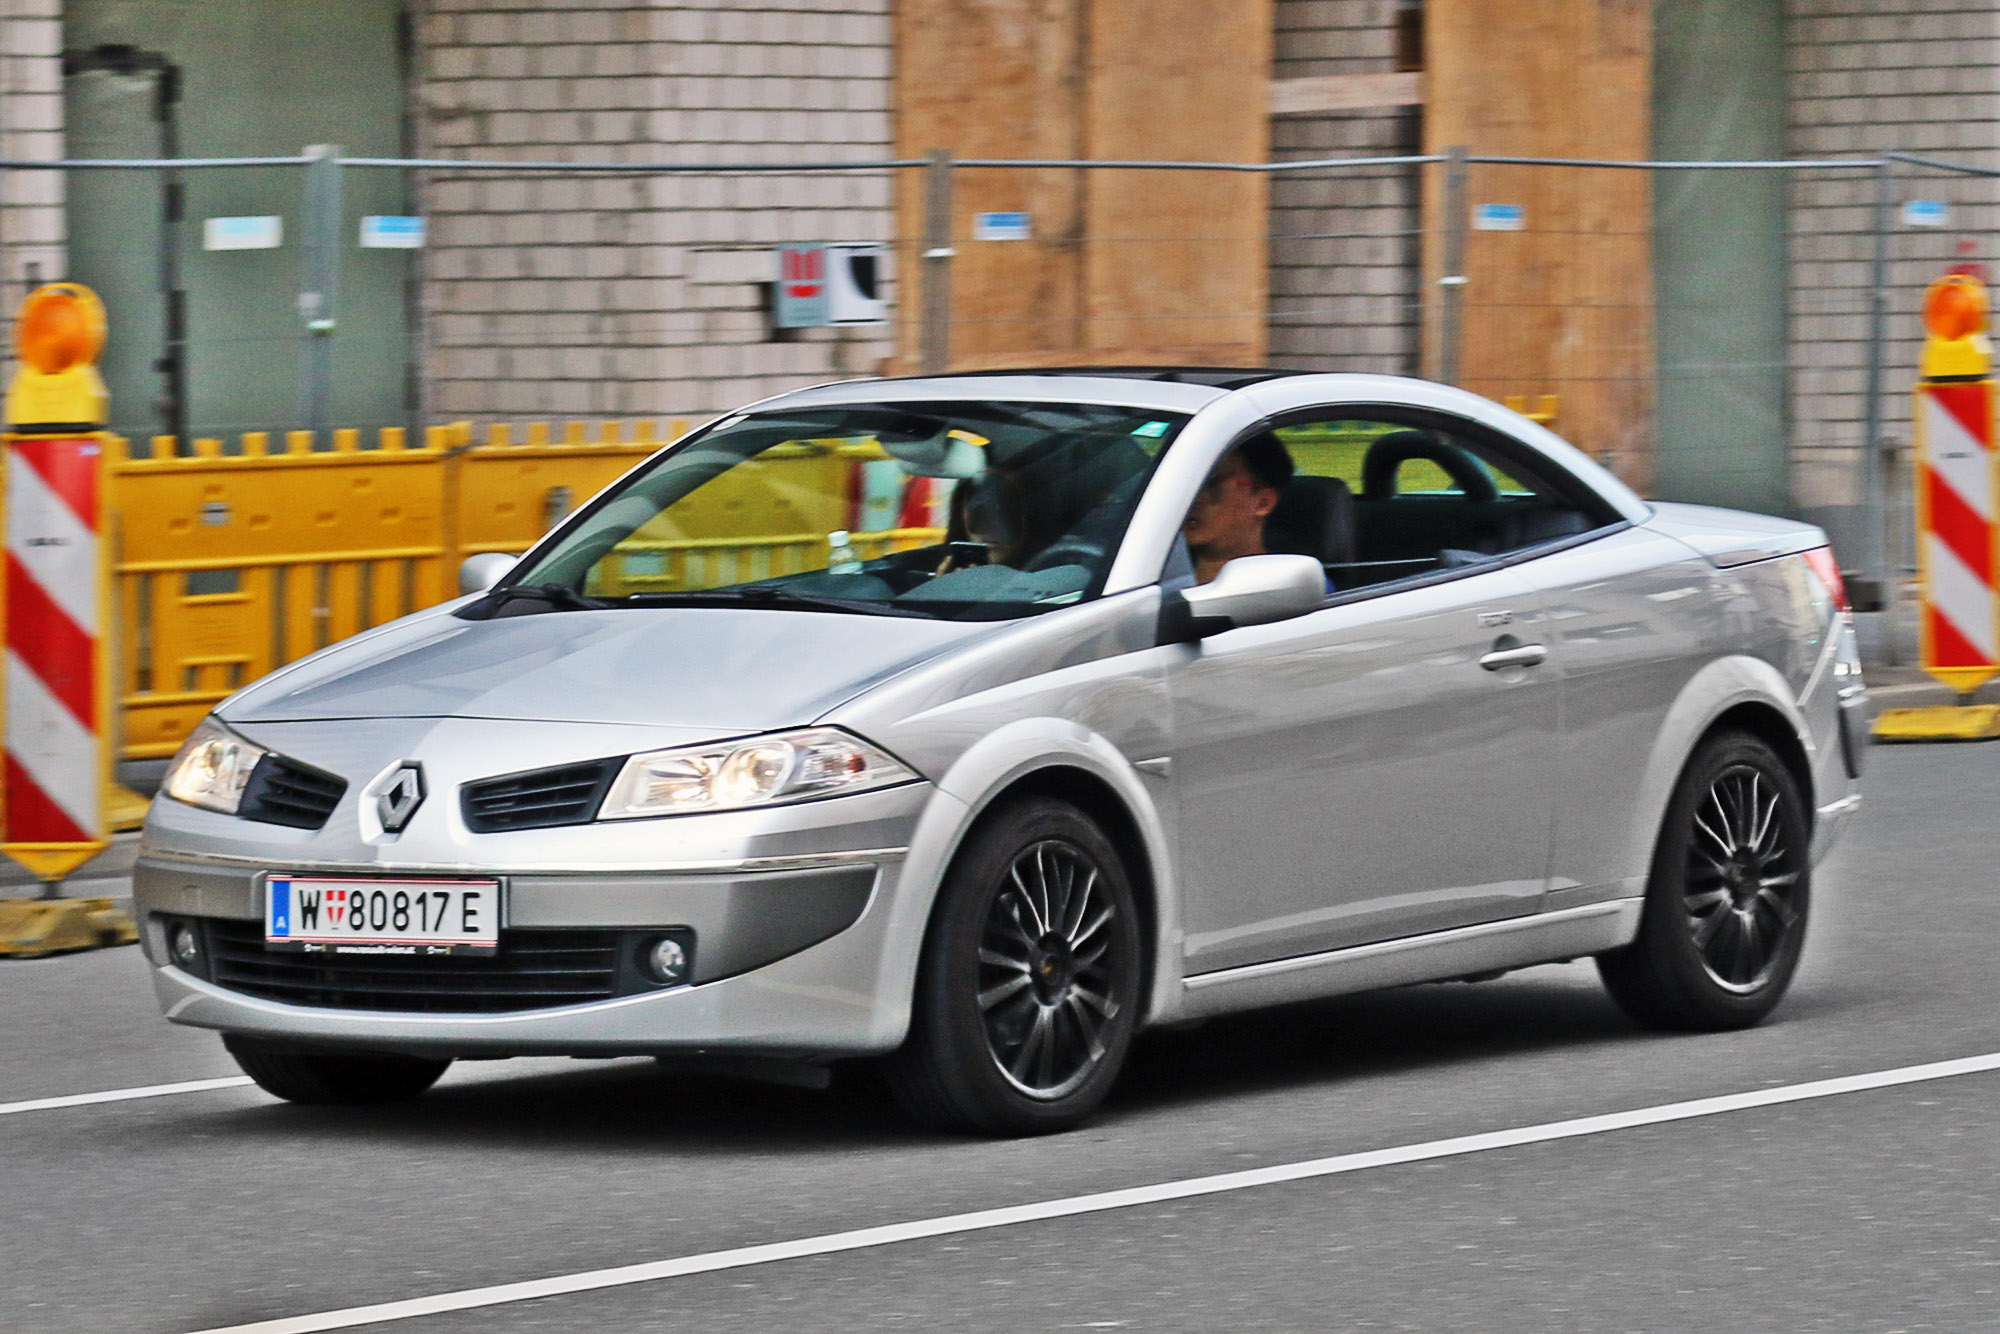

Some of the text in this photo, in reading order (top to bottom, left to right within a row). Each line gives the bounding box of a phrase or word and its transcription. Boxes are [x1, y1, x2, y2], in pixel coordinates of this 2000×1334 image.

[275, 916, 288, 929] A
[299, 890, 481, 933] W 80817 E
